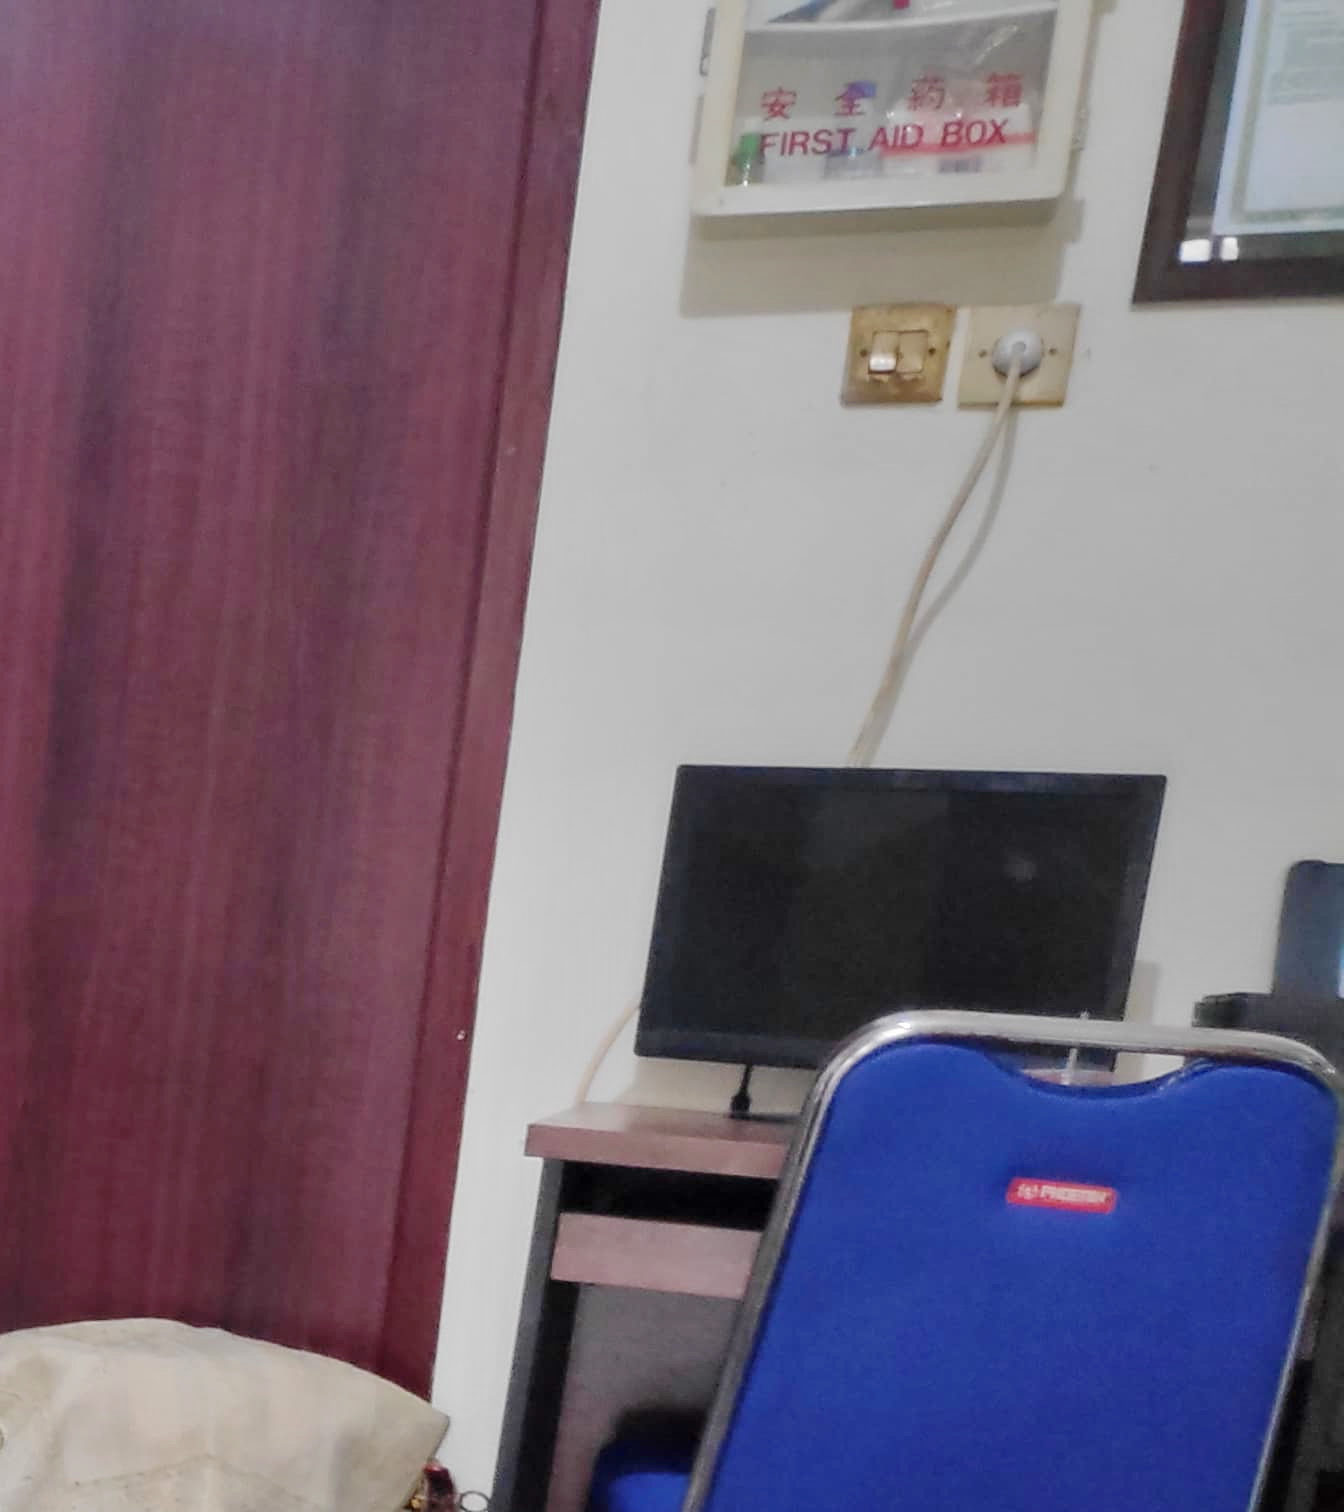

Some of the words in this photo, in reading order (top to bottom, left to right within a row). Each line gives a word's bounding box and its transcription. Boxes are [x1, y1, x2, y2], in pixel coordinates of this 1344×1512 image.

[758, 127, 858, 158] FIRST
[867, 124, 925, 151] AID
[940, 118, 1010, 147] BOX
